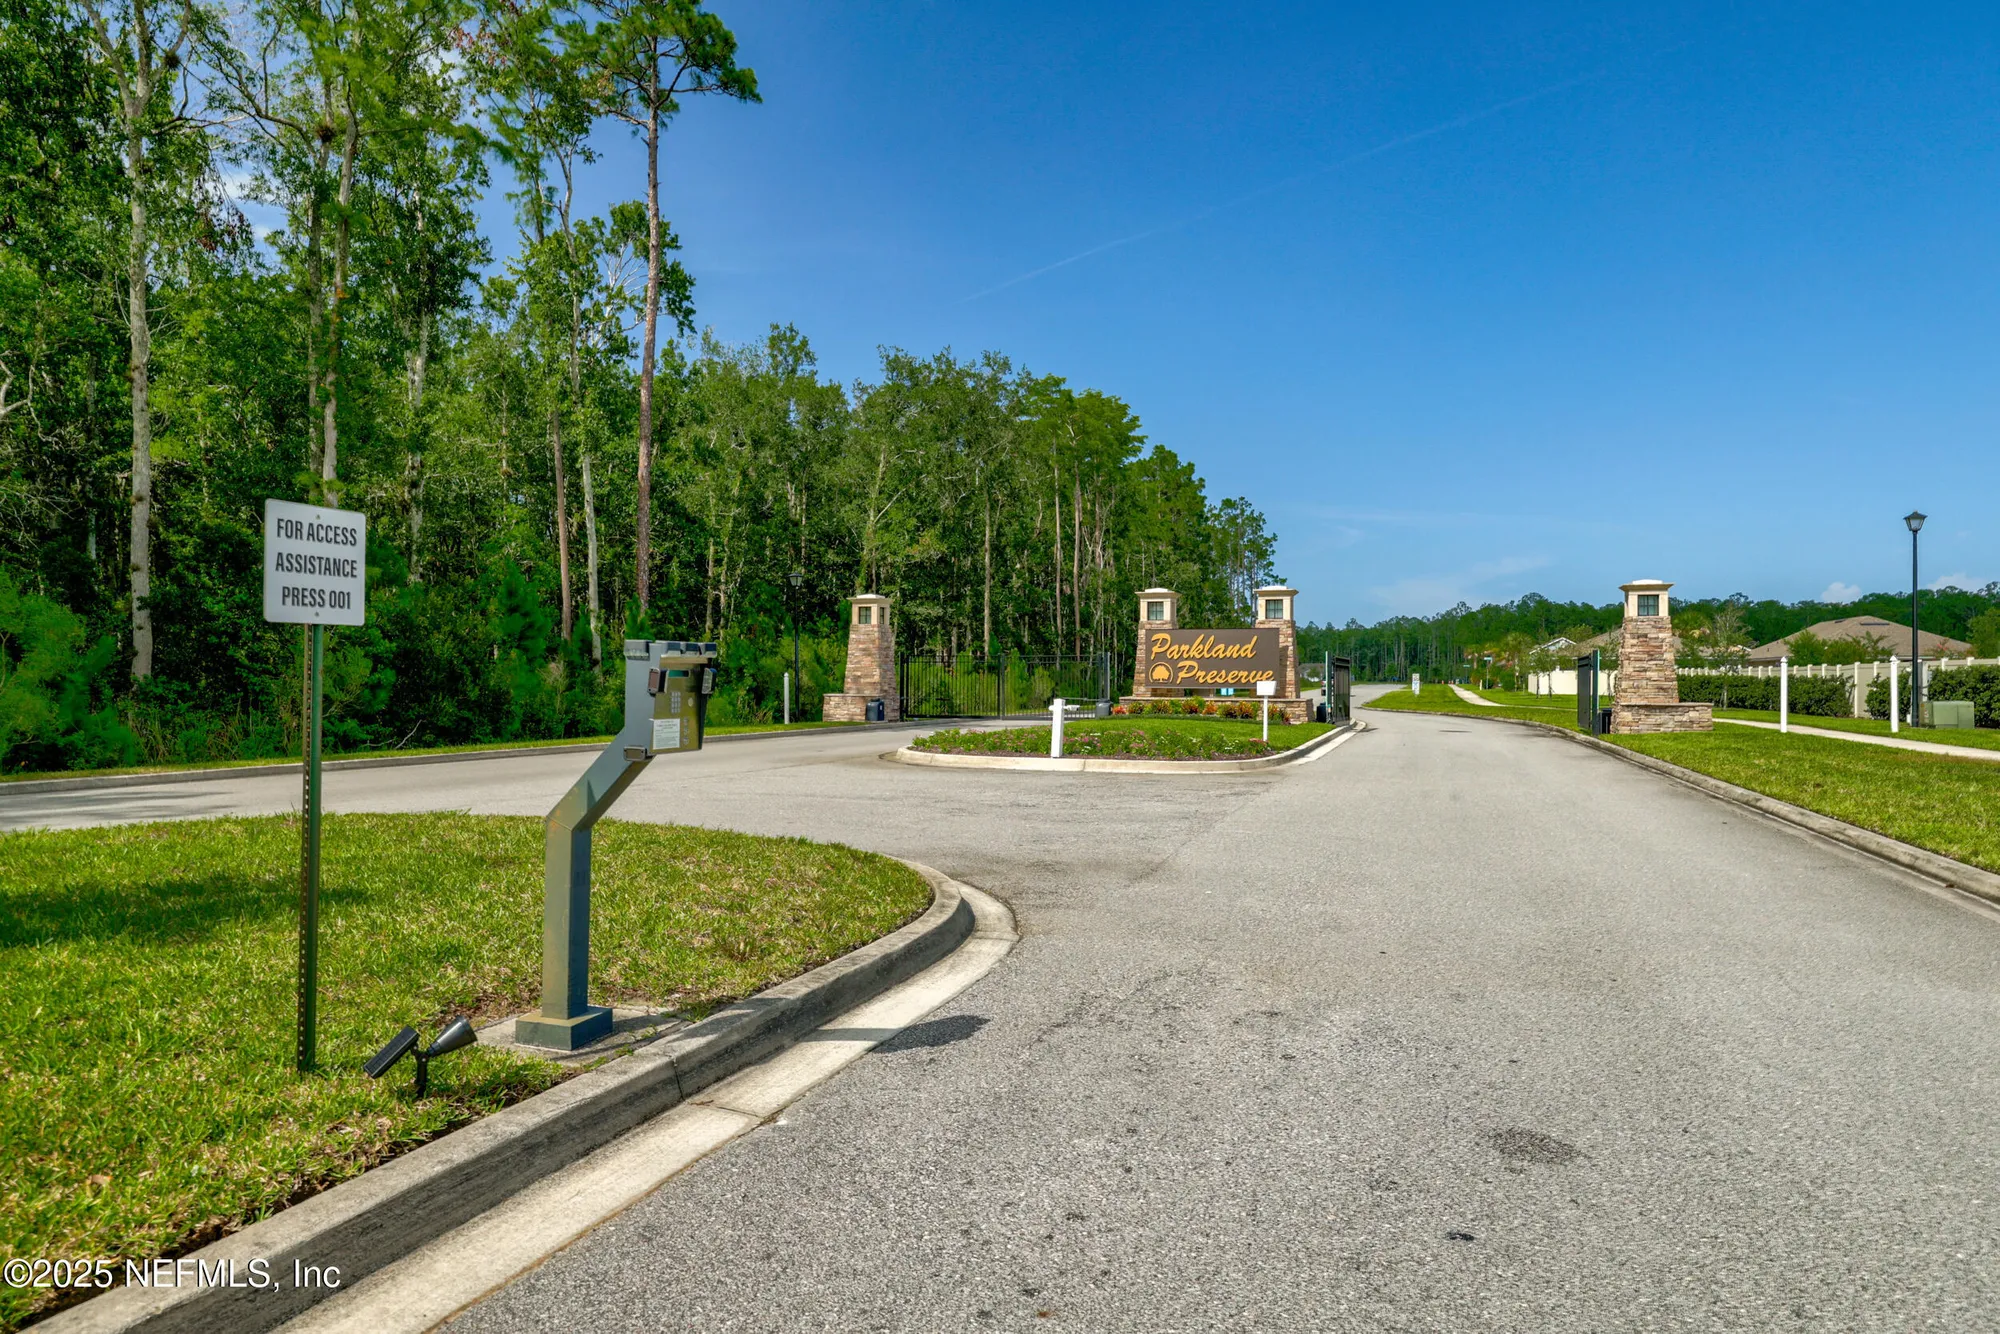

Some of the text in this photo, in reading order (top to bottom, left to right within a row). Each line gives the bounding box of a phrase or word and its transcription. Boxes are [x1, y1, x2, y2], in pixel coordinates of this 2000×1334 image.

[276, 518, 357, 547] FOR ACCESS
[275, 552, 357, 578] ASSISTANCE
[282, 586, 351, 609] PRESS 001
[1151, 632, 1258, 660] Parkland
[1176, 660, 1275, 685] Preserve
